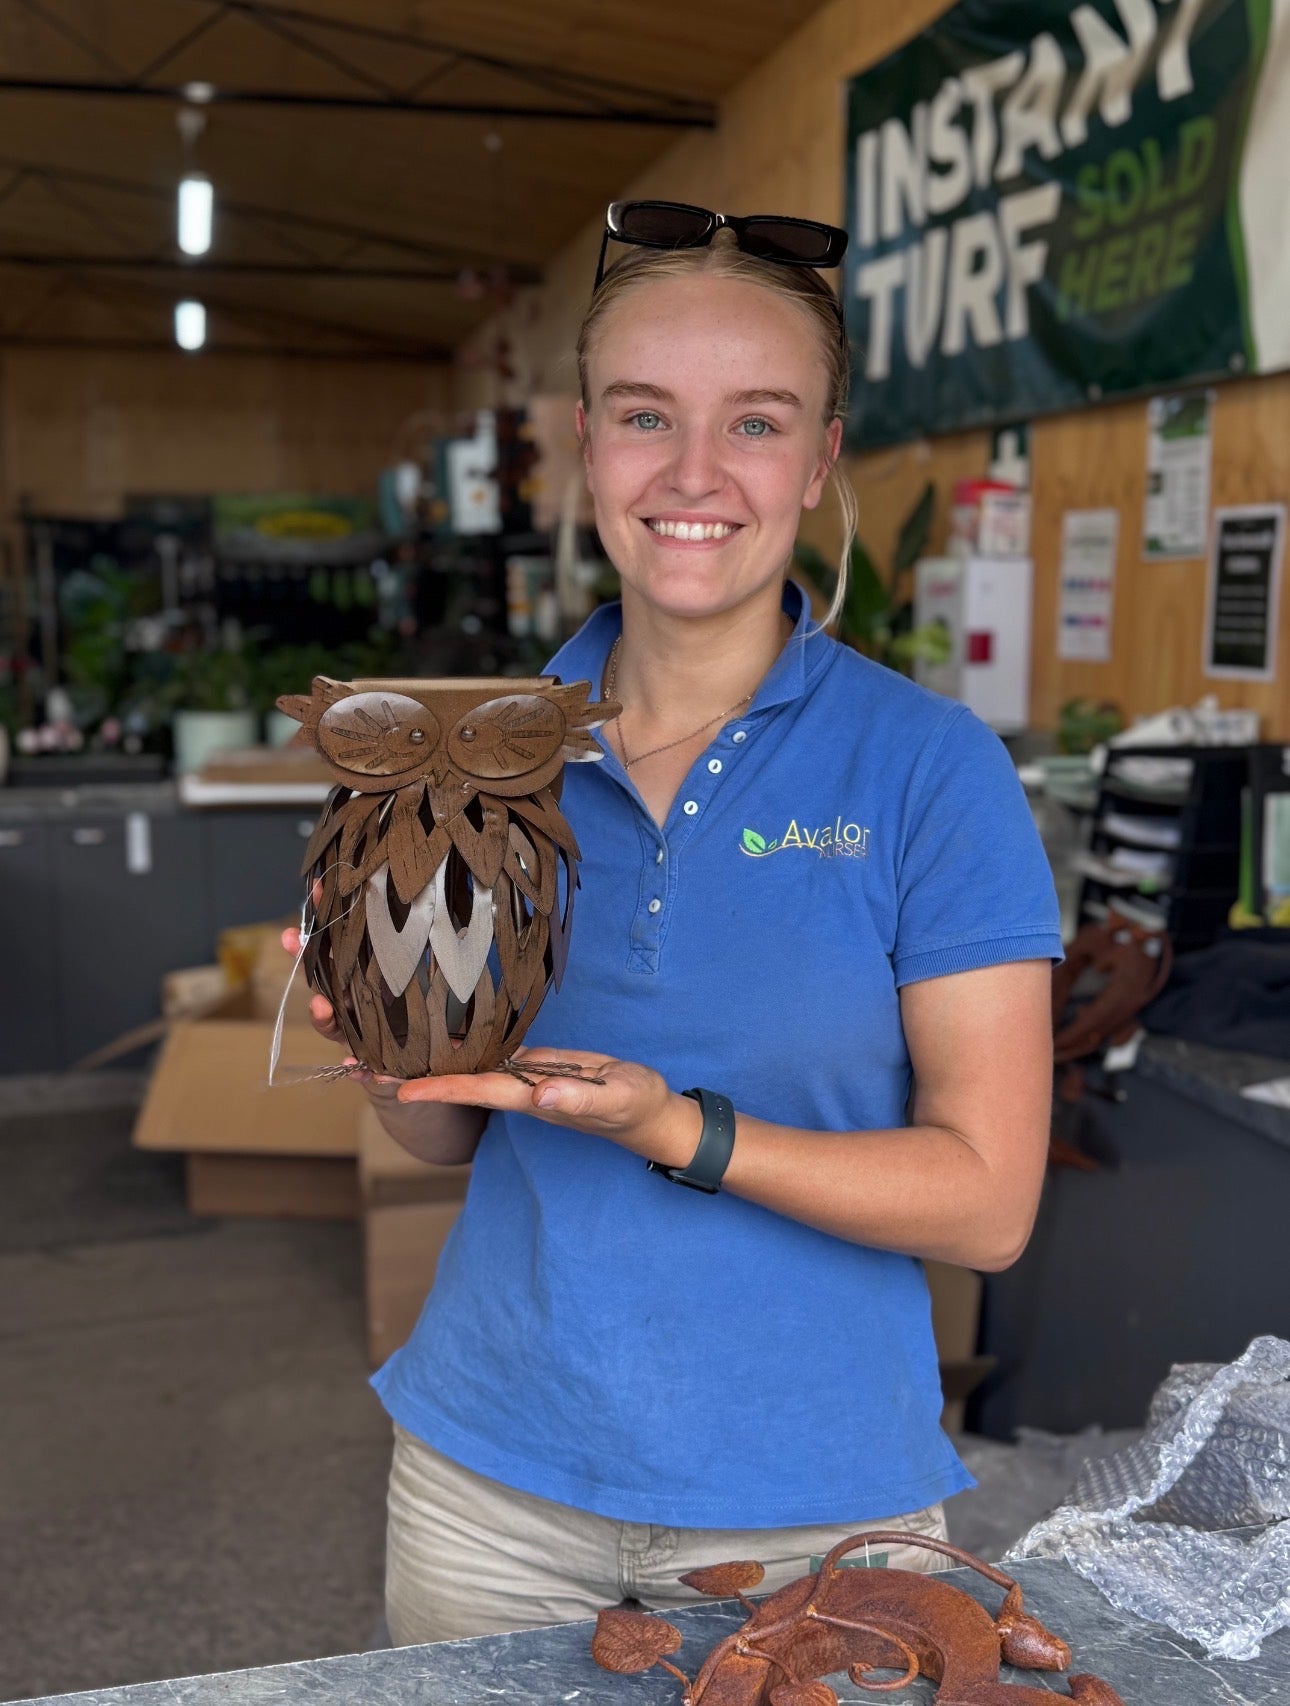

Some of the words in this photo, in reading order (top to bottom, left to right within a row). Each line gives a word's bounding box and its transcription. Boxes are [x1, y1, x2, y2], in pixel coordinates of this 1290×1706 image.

[1072, 116, 1215, 241] SOLD
[857, 181, 1061, 381] TURF
[1057, 204, 1200, 320] HERE
